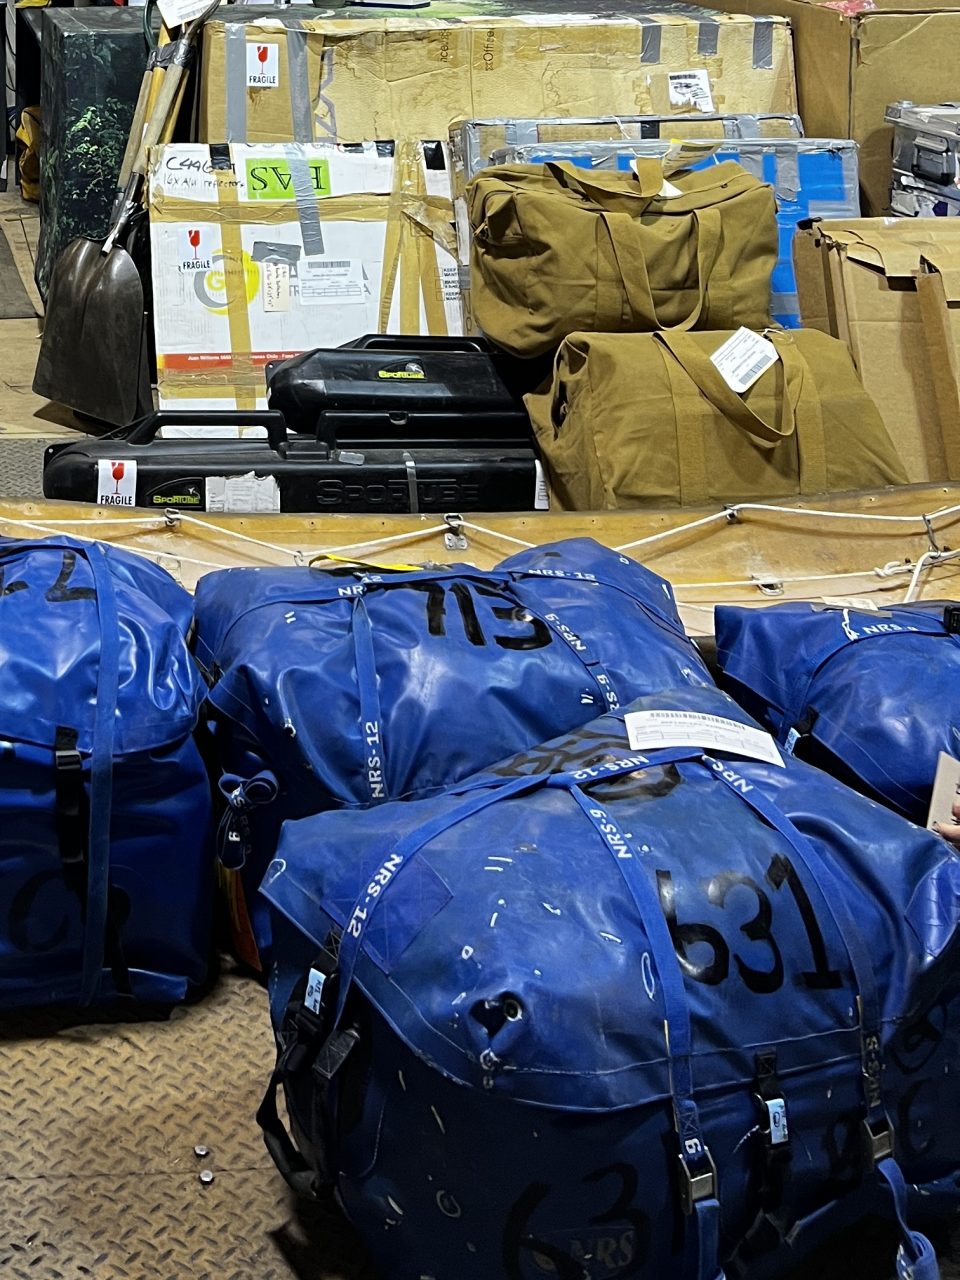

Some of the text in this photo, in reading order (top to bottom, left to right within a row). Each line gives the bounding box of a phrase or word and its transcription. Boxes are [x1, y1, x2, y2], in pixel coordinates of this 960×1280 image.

[248, 75, 276, 84] FRAGILE
[182, 260, 211, 269] FRAGILE
[100, 495, 133, 505] FRAGILE
[395, 581, 553, 651] 713
[545, 612, 588, 652] NRS-9
[365, 721, 386, 799] NRS-12
[573, 754, 650, 781] NRS-12
[590, 807, 633, 860] NRS-9
[346, 853, 404, 940] NRS-12
[655, 852, 843, 995] 631
